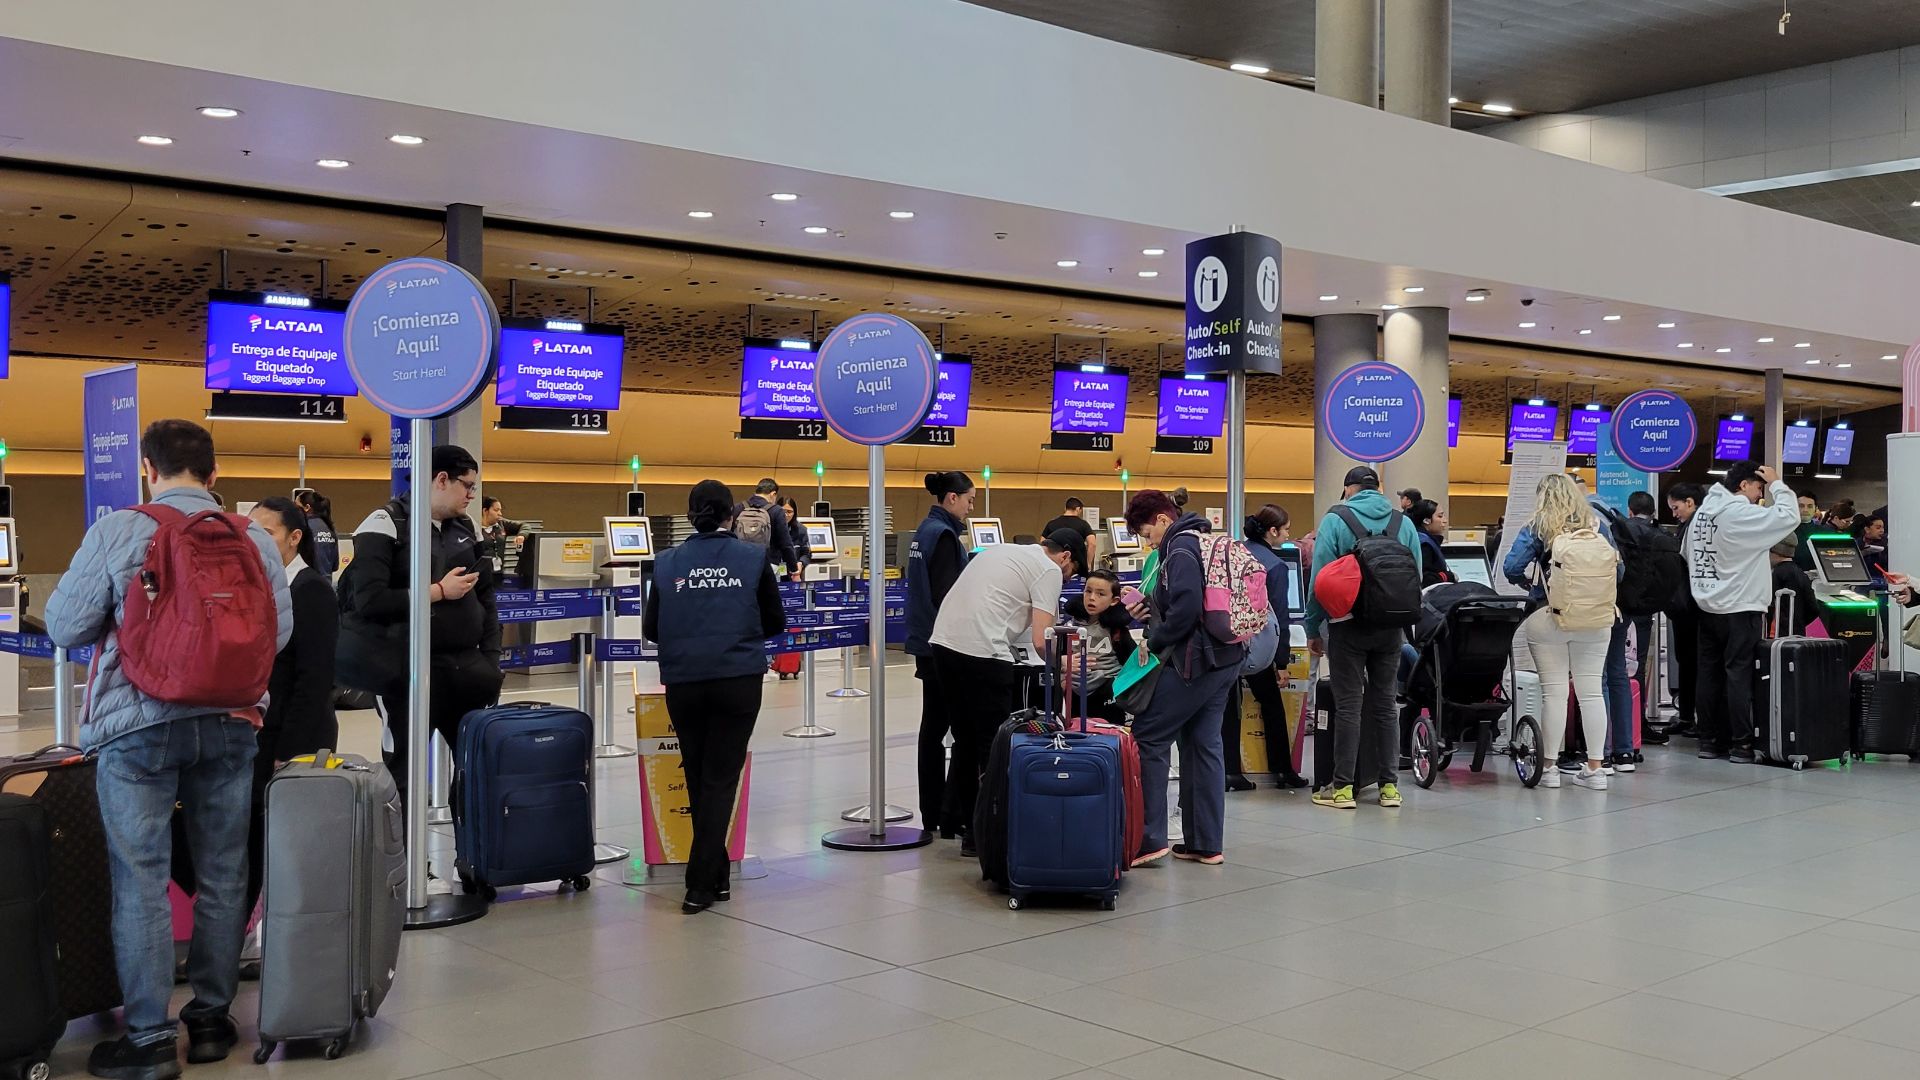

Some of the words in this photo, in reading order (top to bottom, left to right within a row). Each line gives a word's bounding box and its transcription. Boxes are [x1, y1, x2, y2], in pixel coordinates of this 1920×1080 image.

[400, 277, 440, 289] LATAM
[265, 320, 323, 333] LATAM
[372, 311, 460, 337] ¡Comienza
[1187, 318, 1241, 340] Auto/Self
[858, 329, 891, 340] LATAM
[232, 343, 274, 357] Entrega
[276, 346, 290, 357] de
[292, 347, 337, 362] Equipaje
[396, 335, 440, 358] Aquí!
[545, 343, 592, 355] LATAM
[1187, 341, 1231, 360] Check-in
[1247, 340, 1279, 359] Check-in
[256, 360, 314, 374] Etiquetado
[392, 368, 417, 381] Start
[421, 366, 446, 379] Here!
[518, 364, 552, 376] Entrega
[554, 366, 565, 376] de
[567, 367, 603, 380] Equipaje
[837, 357, 907, 380] ¡Comienza
[242, 372, 270, 384] Tagged
[273, 375, 305, 385] Baggage
[307, 376, 325, 386] Drop
[537, 380, 584, 391] Etiquetado
[758, 380, 785, 391] Entrega
[786, 381, 795, 390] de
[856, 376, 891, 396] Aquí!
[1081, 382, 1109, 390] LATAM
[525, 390, 548, 400] Tagged
[550, 392, 576, 401] Baggage
[578, 393, 593, 401] Drop
[772, 393, 811, 403] Etiquetado
[116, 396, 135, 410] LATAM
[300, 400, 336, 416] 114
[854, 404, 874, 415] Start
[876, 402, 898, 413] Here!
[1344, 396, 1403, 410] ¡Comienza
[571, 414, 601, 427] 113
[1358, 411, 1388, 425] Aquí!
[1630, 417, 1680, 429] ¡Comienza
[798, 424, 822, 437] 112
[929, 430, 950, 442] 111
[1643, 430, 1668, 442] Aquí!
[111, 432, 128, 450] Express
[1092, 437, 1110, 448] 110
[1193, 440, 1209, 450] 109
[689, 567, 728, 578] APOYO
[689, 578, 742, 588] LATAM
[658, 742, 680, 750] Aut
[668, 783, 684, 791] Self
